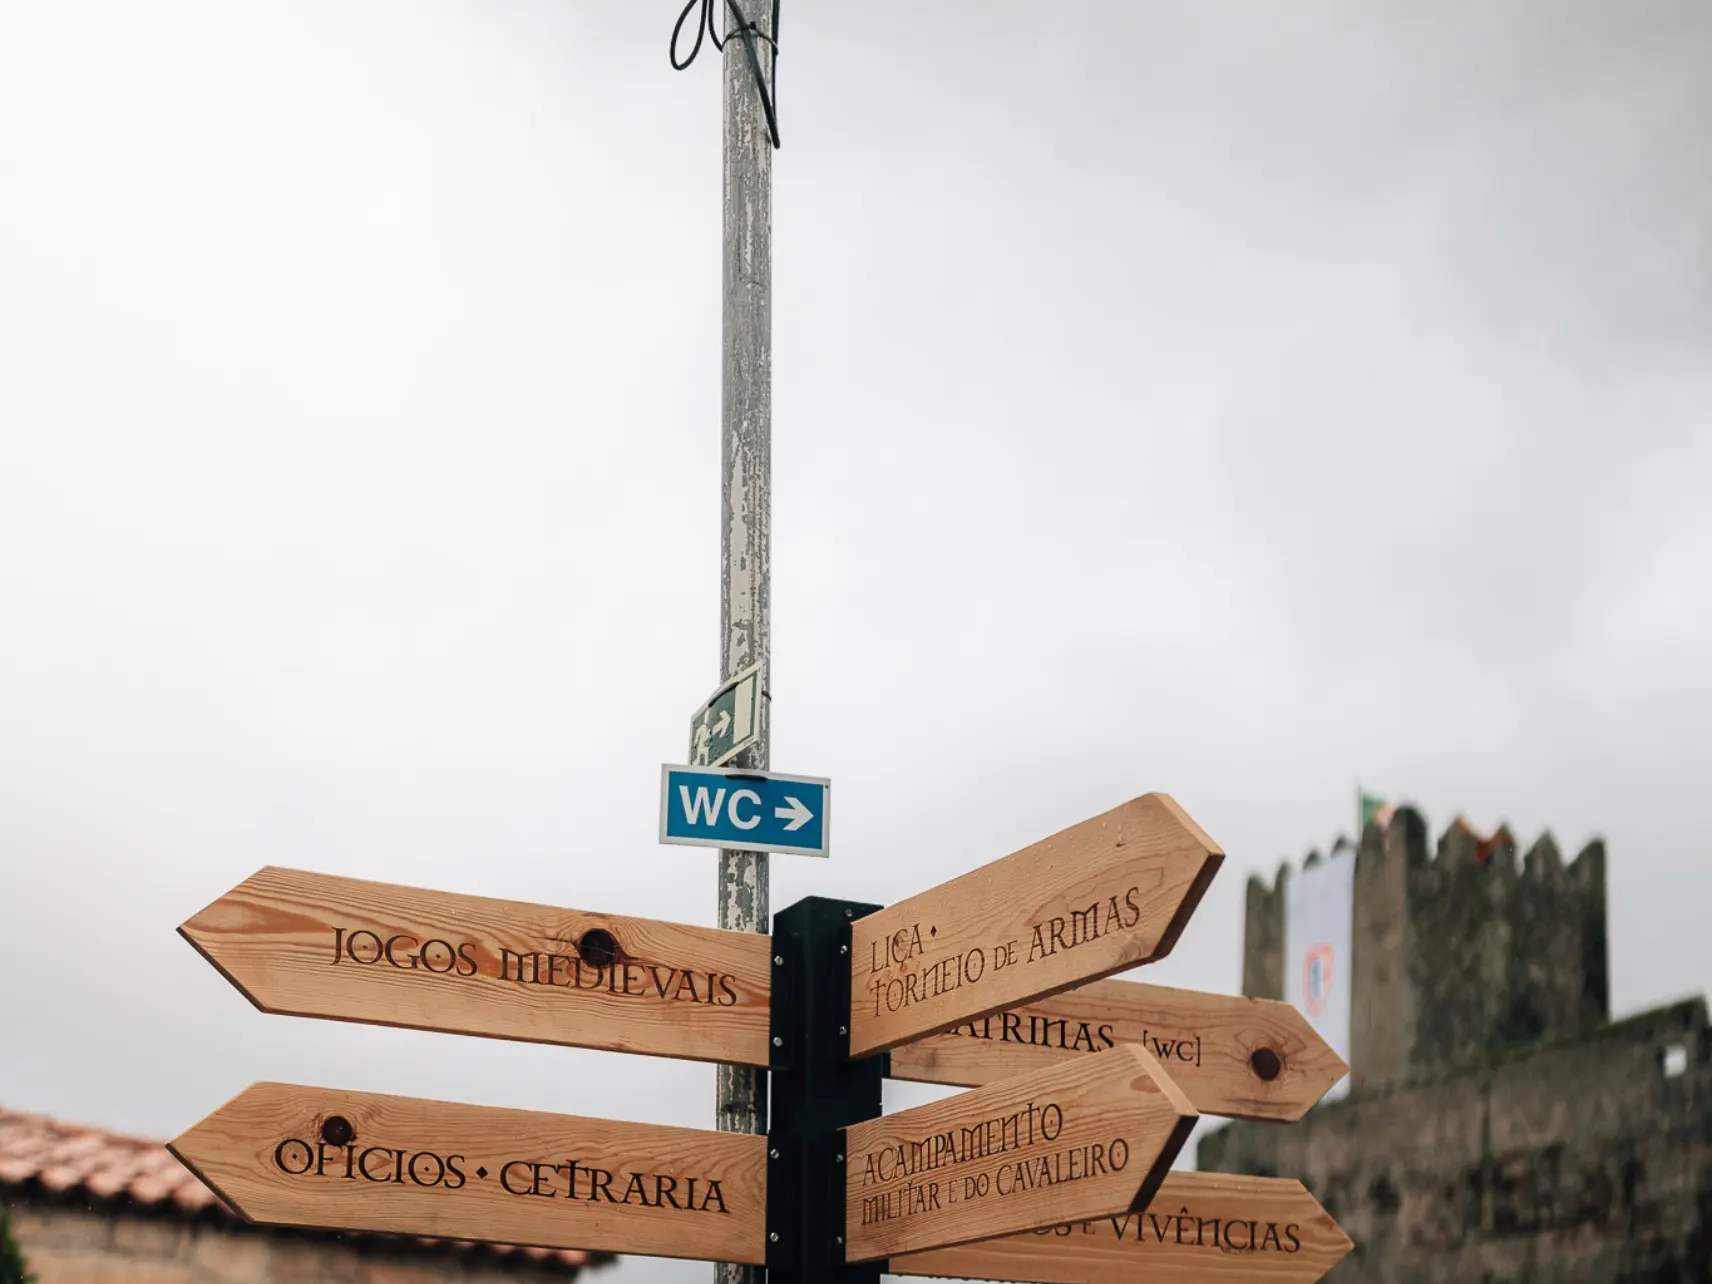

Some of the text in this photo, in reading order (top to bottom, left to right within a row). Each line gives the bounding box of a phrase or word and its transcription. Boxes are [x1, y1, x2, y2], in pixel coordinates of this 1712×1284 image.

[678, 785, 762, 830] WC
[331, 926, 738, 1008] JOGOS MEDIEVAIS
[870, 886, 1141, 1018] TORNEIO DE ARMAS
[942, 1011, 1116, 1052] ATRINAS
[861, 1101, 1063, 1187] ACAMPAMENTO
[500, 1158, 730, 1214] CETRARIA
[861, 1137, 1130, 1227] MILITAR E DO CAVALEIRO
[1110, 1206, 1301, 1254] VIVÊNCIAS
